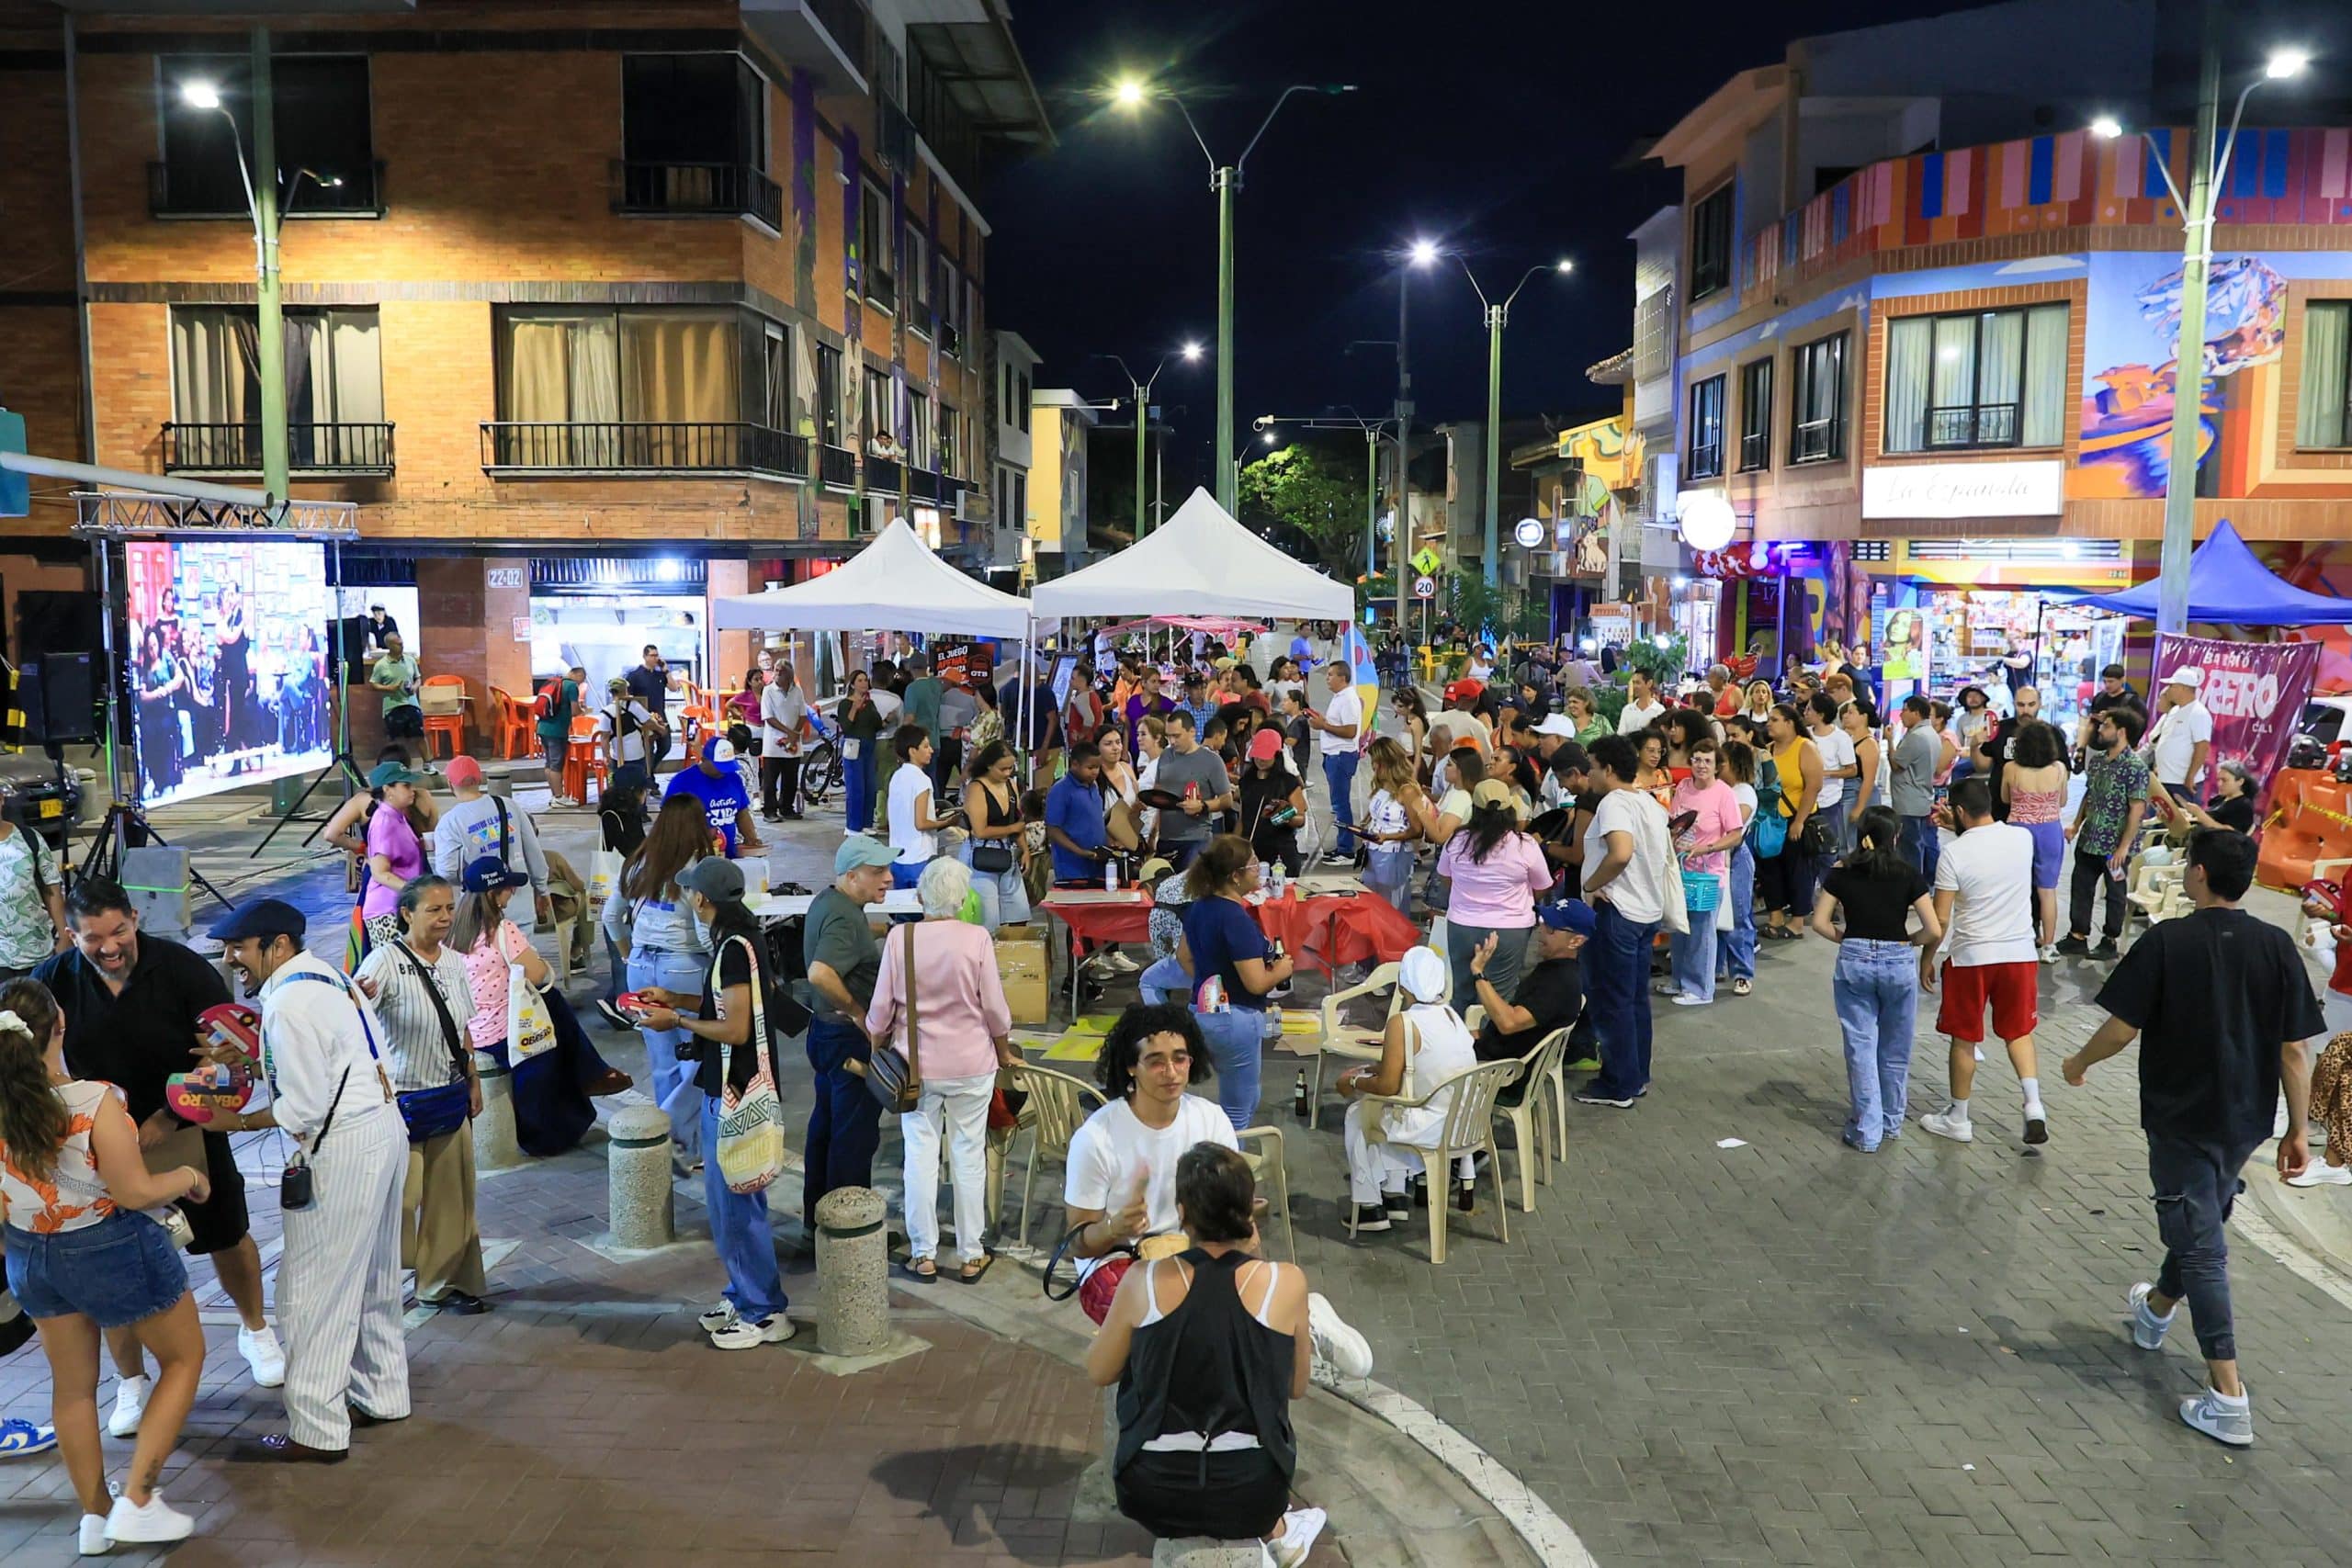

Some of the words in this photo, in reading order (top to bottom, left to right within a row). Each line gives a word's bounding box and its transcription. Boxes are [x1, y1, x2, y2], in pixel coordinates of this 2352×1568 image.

[1418, 582, 1432, 593] 20
[937, 652, 945, 660] EL
[946, 646, 968, 659] JUEGO
[2192, 668, 2279, 720] RERO
[177, 1093, 243, 1108] OBRO
